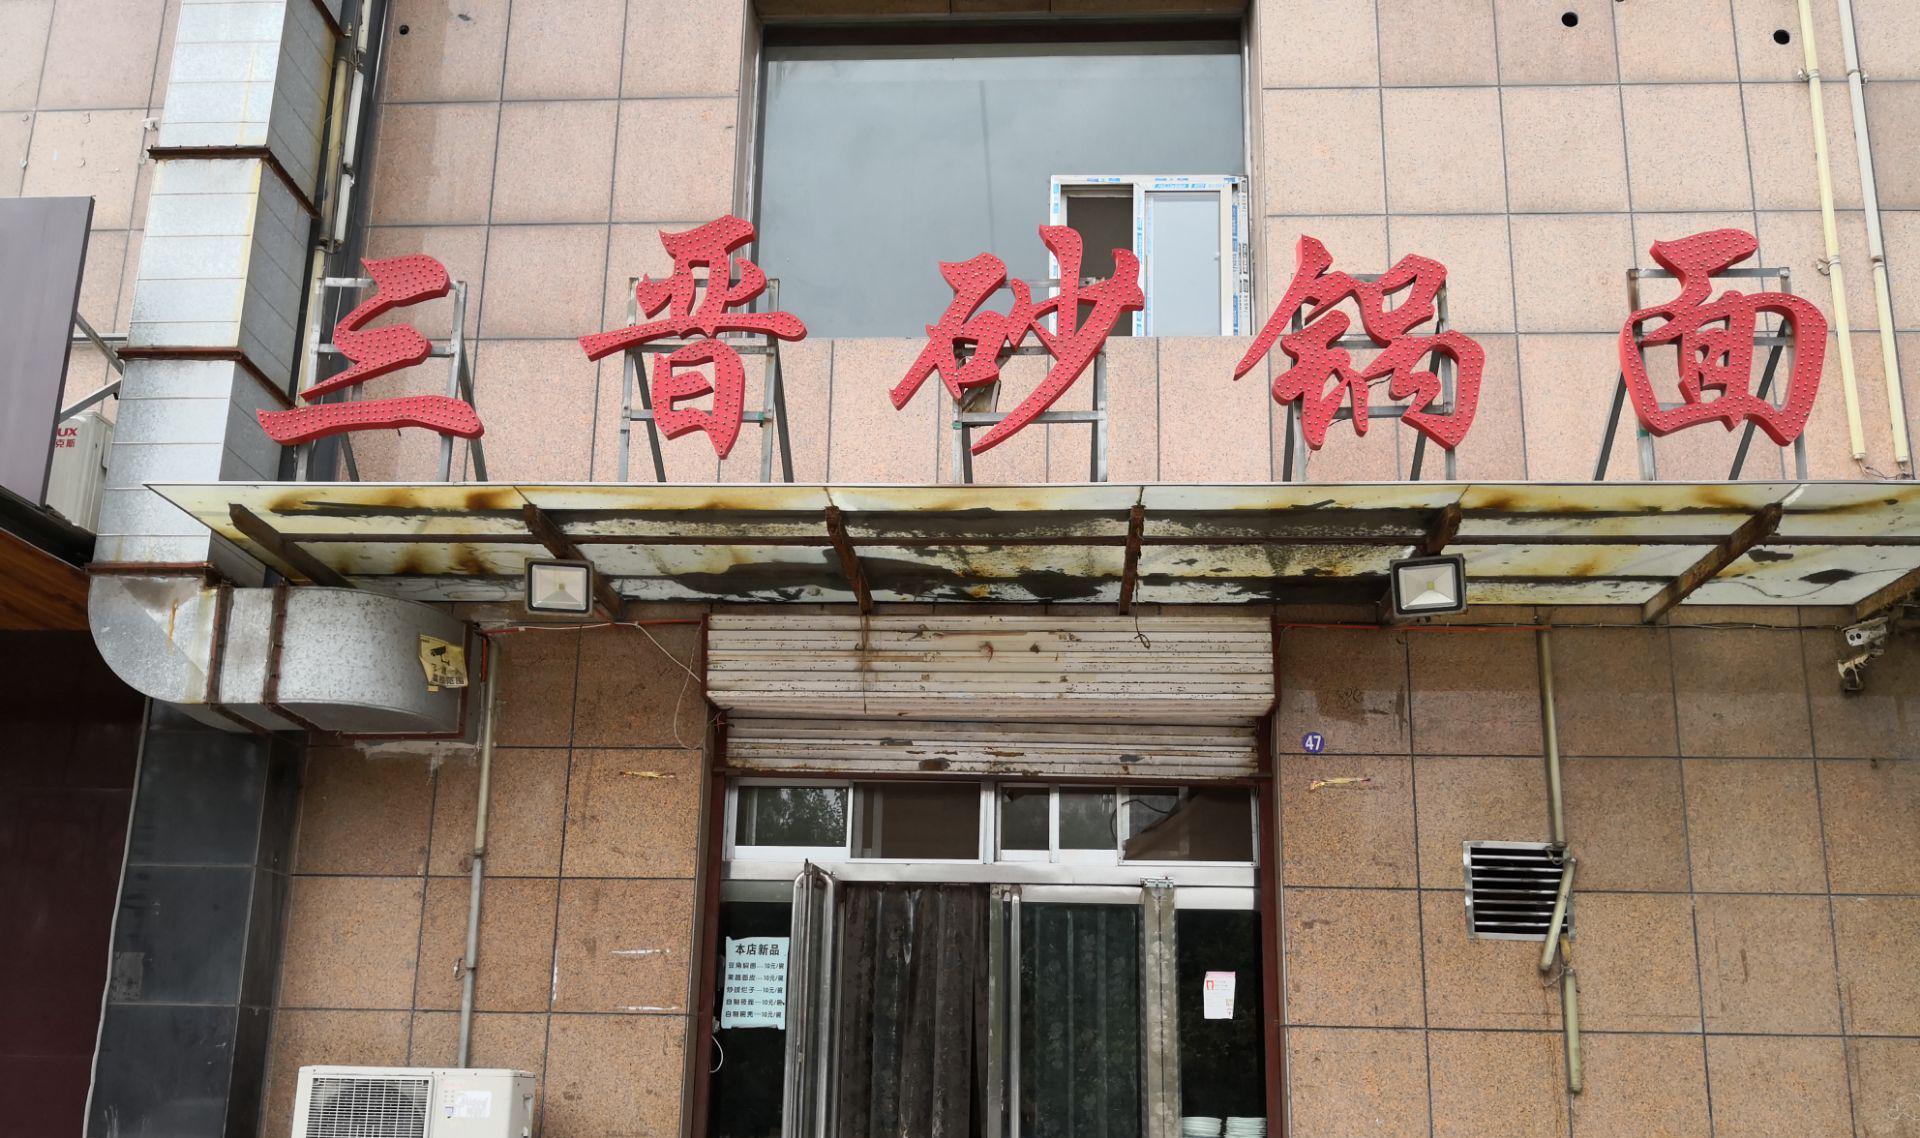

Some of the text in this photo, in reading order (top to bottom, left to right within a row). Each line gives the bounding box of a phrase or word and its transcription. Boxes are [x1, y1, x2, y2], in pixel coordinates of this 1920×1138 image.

[1305, 735, 1321, 750] 47
[735, 943, 780, 956] 本店新品
